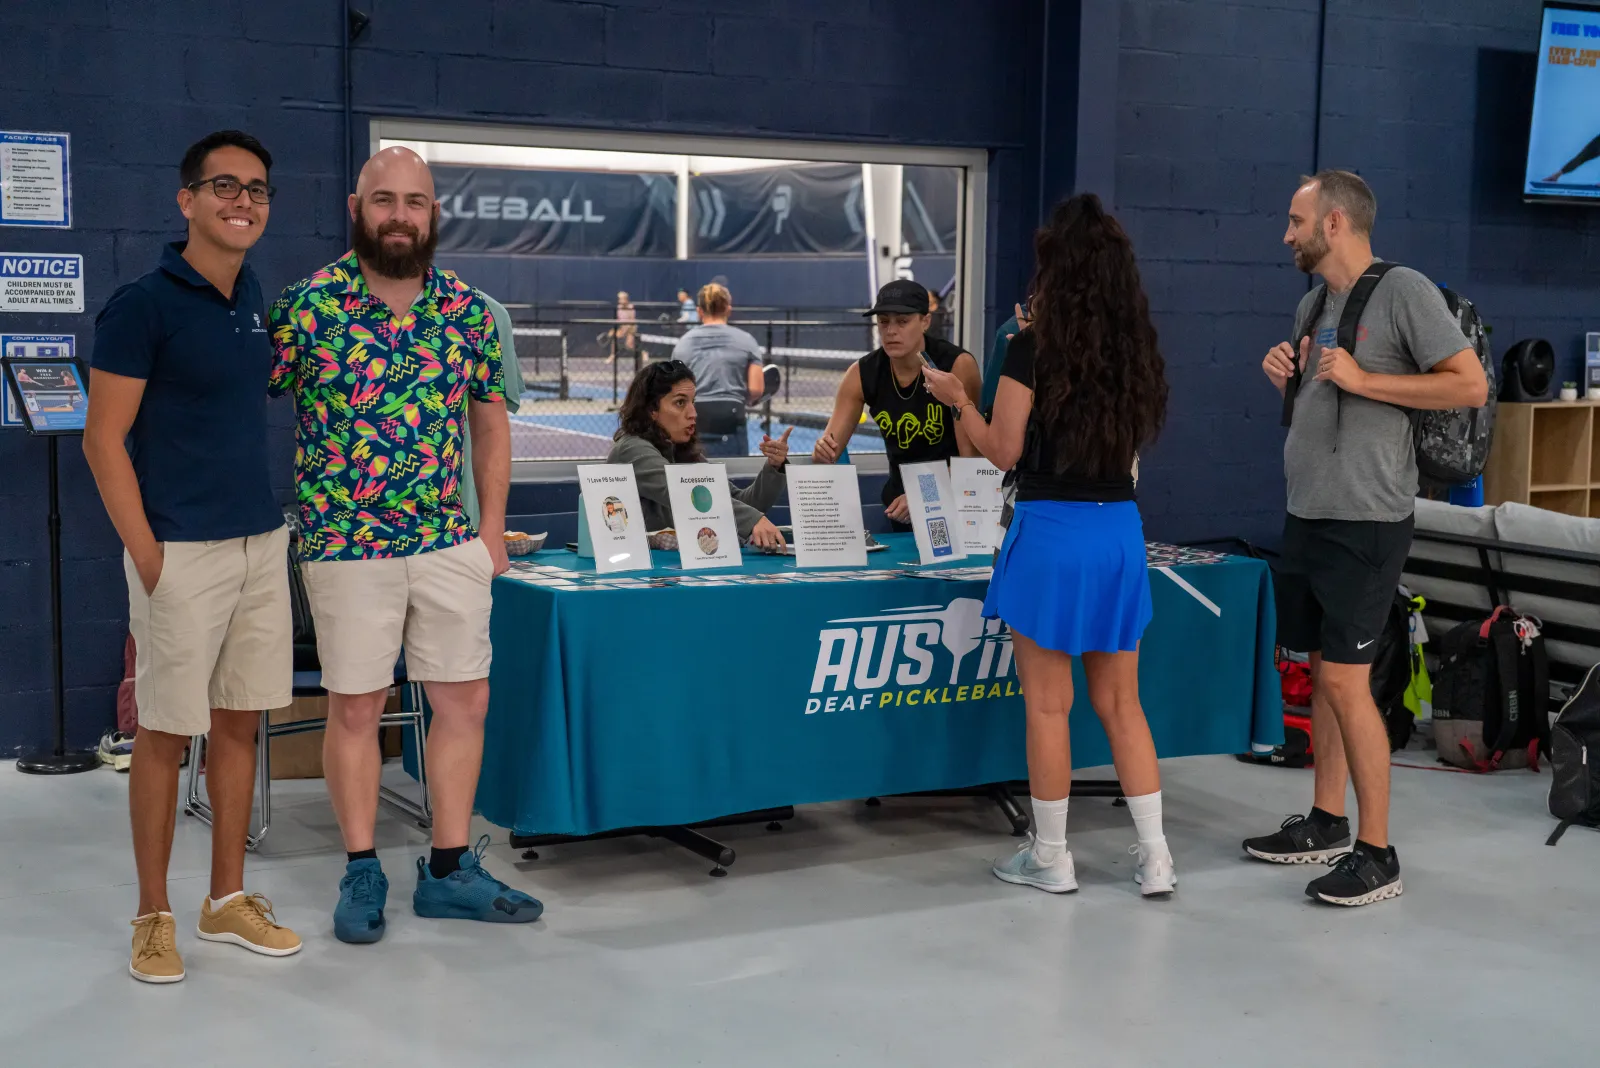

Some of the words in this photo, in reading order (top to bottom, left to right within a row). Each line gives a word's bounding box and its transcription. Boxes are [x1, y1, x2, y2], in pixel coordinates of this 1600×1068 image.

[440, 194, 606, 222] KLEBALL
[2, 258, 77, 275] NOTICE
[680, 476, 715, 484] Accessories
[804, 693, 874, 714] DEAF
[1508, 689, 1519, 721] CRBN
